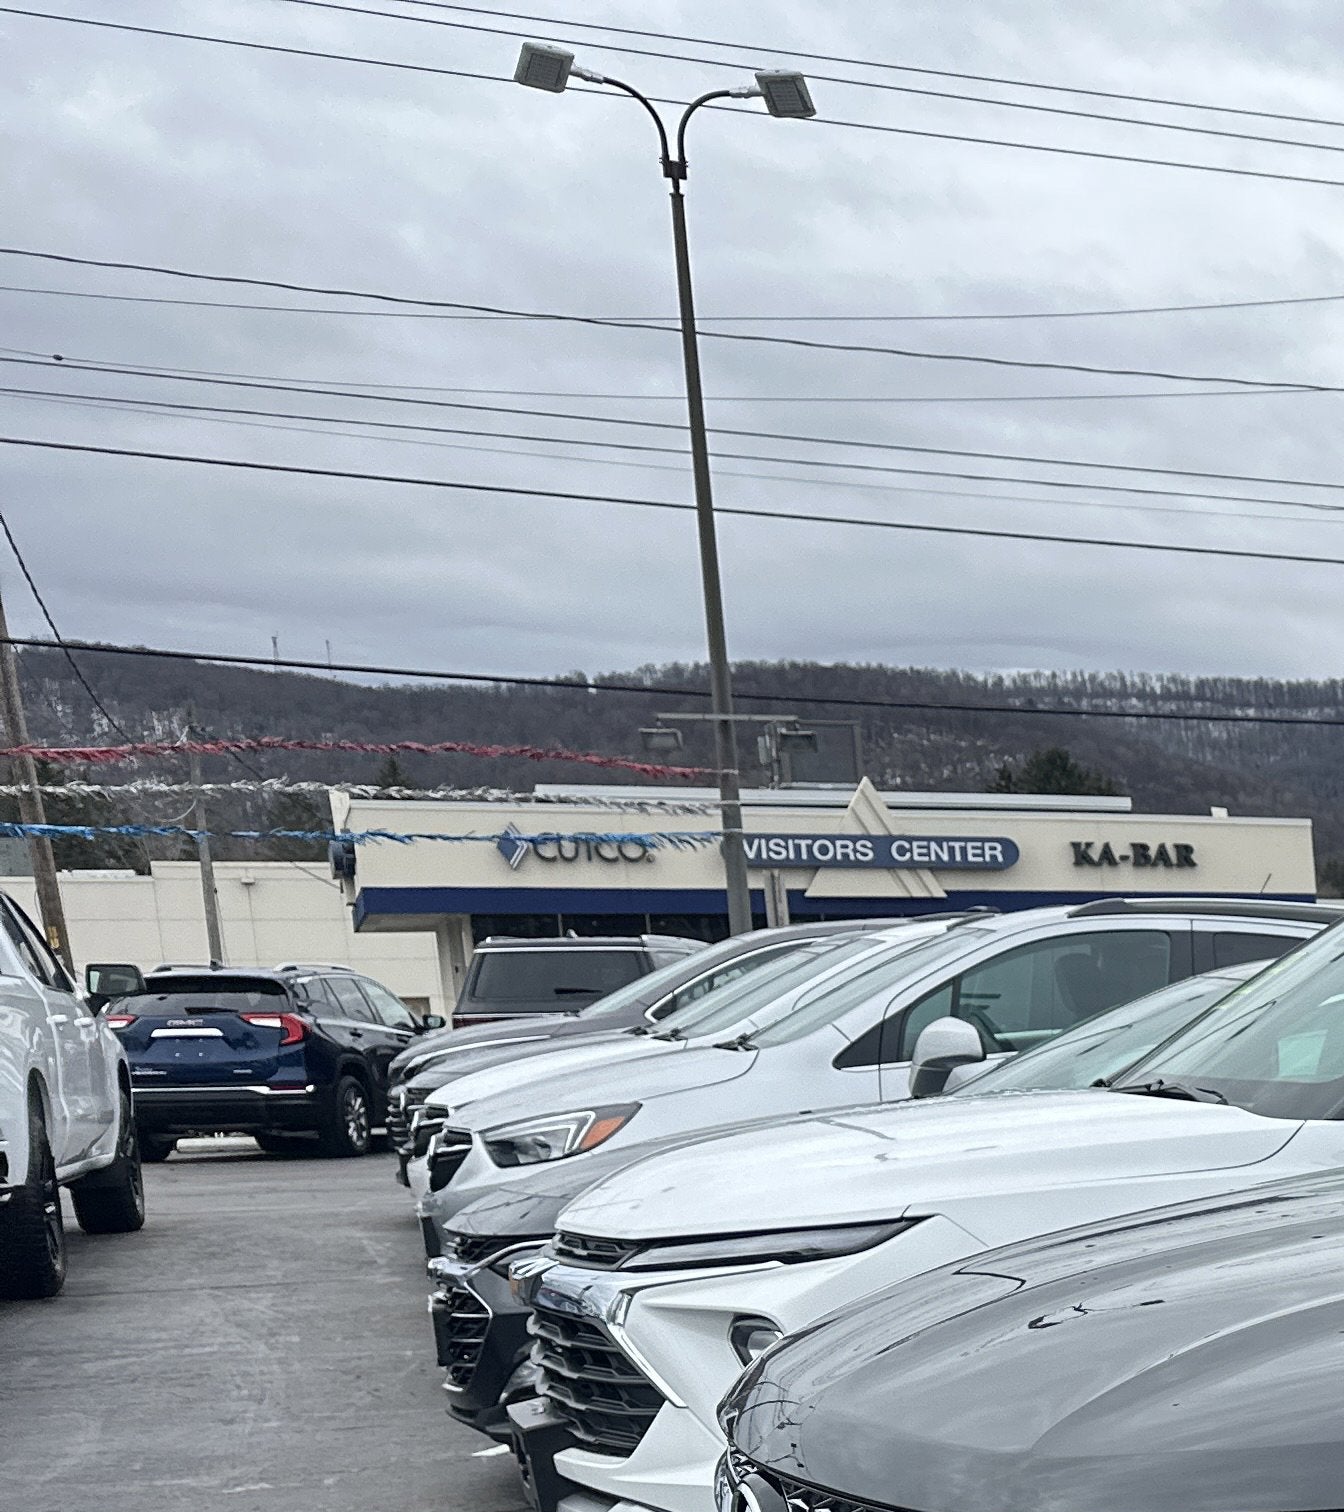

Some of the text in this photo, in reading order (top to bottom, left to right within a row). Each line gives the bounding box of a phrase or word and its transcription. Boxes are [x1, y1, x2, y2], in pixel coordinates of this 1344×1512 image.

[742, 838, 1003, 862] VISITORS CENTER
[1069, 841, 1197, 867] KA-BAR
